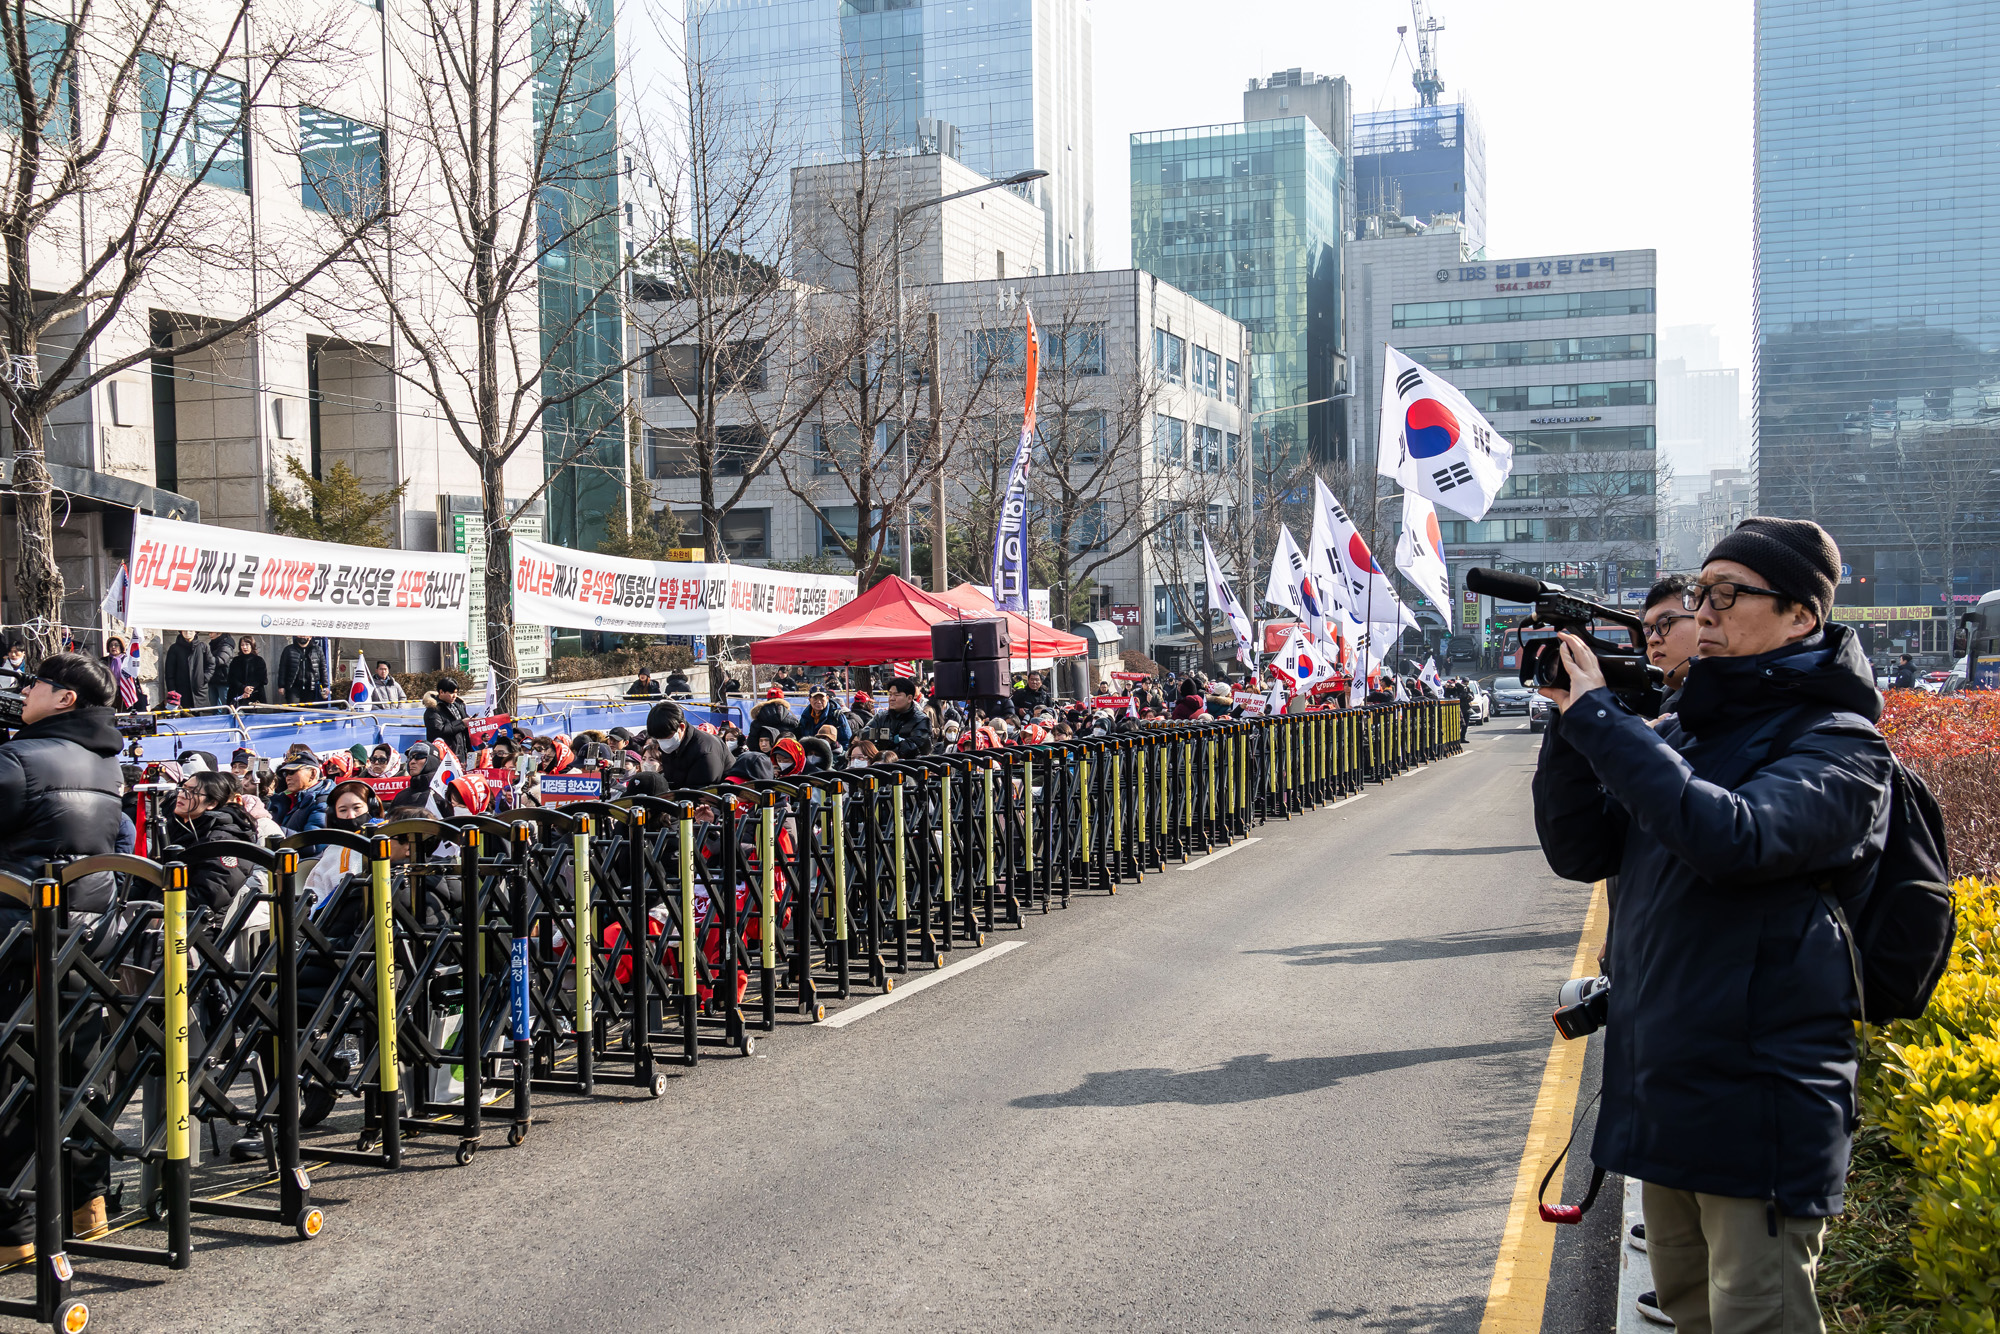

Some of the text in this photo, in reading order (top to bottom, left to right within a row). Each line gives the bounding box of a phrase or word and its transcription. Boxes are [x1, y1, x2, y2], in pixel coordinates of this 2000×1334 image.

[1459, 267, 1486, 281] IBS
[134, 540, 236, 595] 하나님께서
[238, 555, 259, 597] 곧
[260, 558, 331, 602] 이재명과
[331, 565, 395, 607] 공산당을
[396, 571, 466, 610] 심판하신다
[517, 556, 579, 600] 하나님께서
[579, 569, 656, 609] 윤석열대통령님
[658, 578, 679, 610] 부활
[680, 579, 727, 610] 복귀시킨다
[731, 580, 766, 612] 하나님께서
[767, 585, 775, 613] 곧
[775, 586, 801, 614] 이재명과
[802, 588, 826, 615] 공산당을
[1466, 593, 1476, 602] 약
[1112, 608, 1139, 624] 녹취
[469, 719, 486, 727] 우리가
[541, 780, 602, 793] 대장동 항소포기
